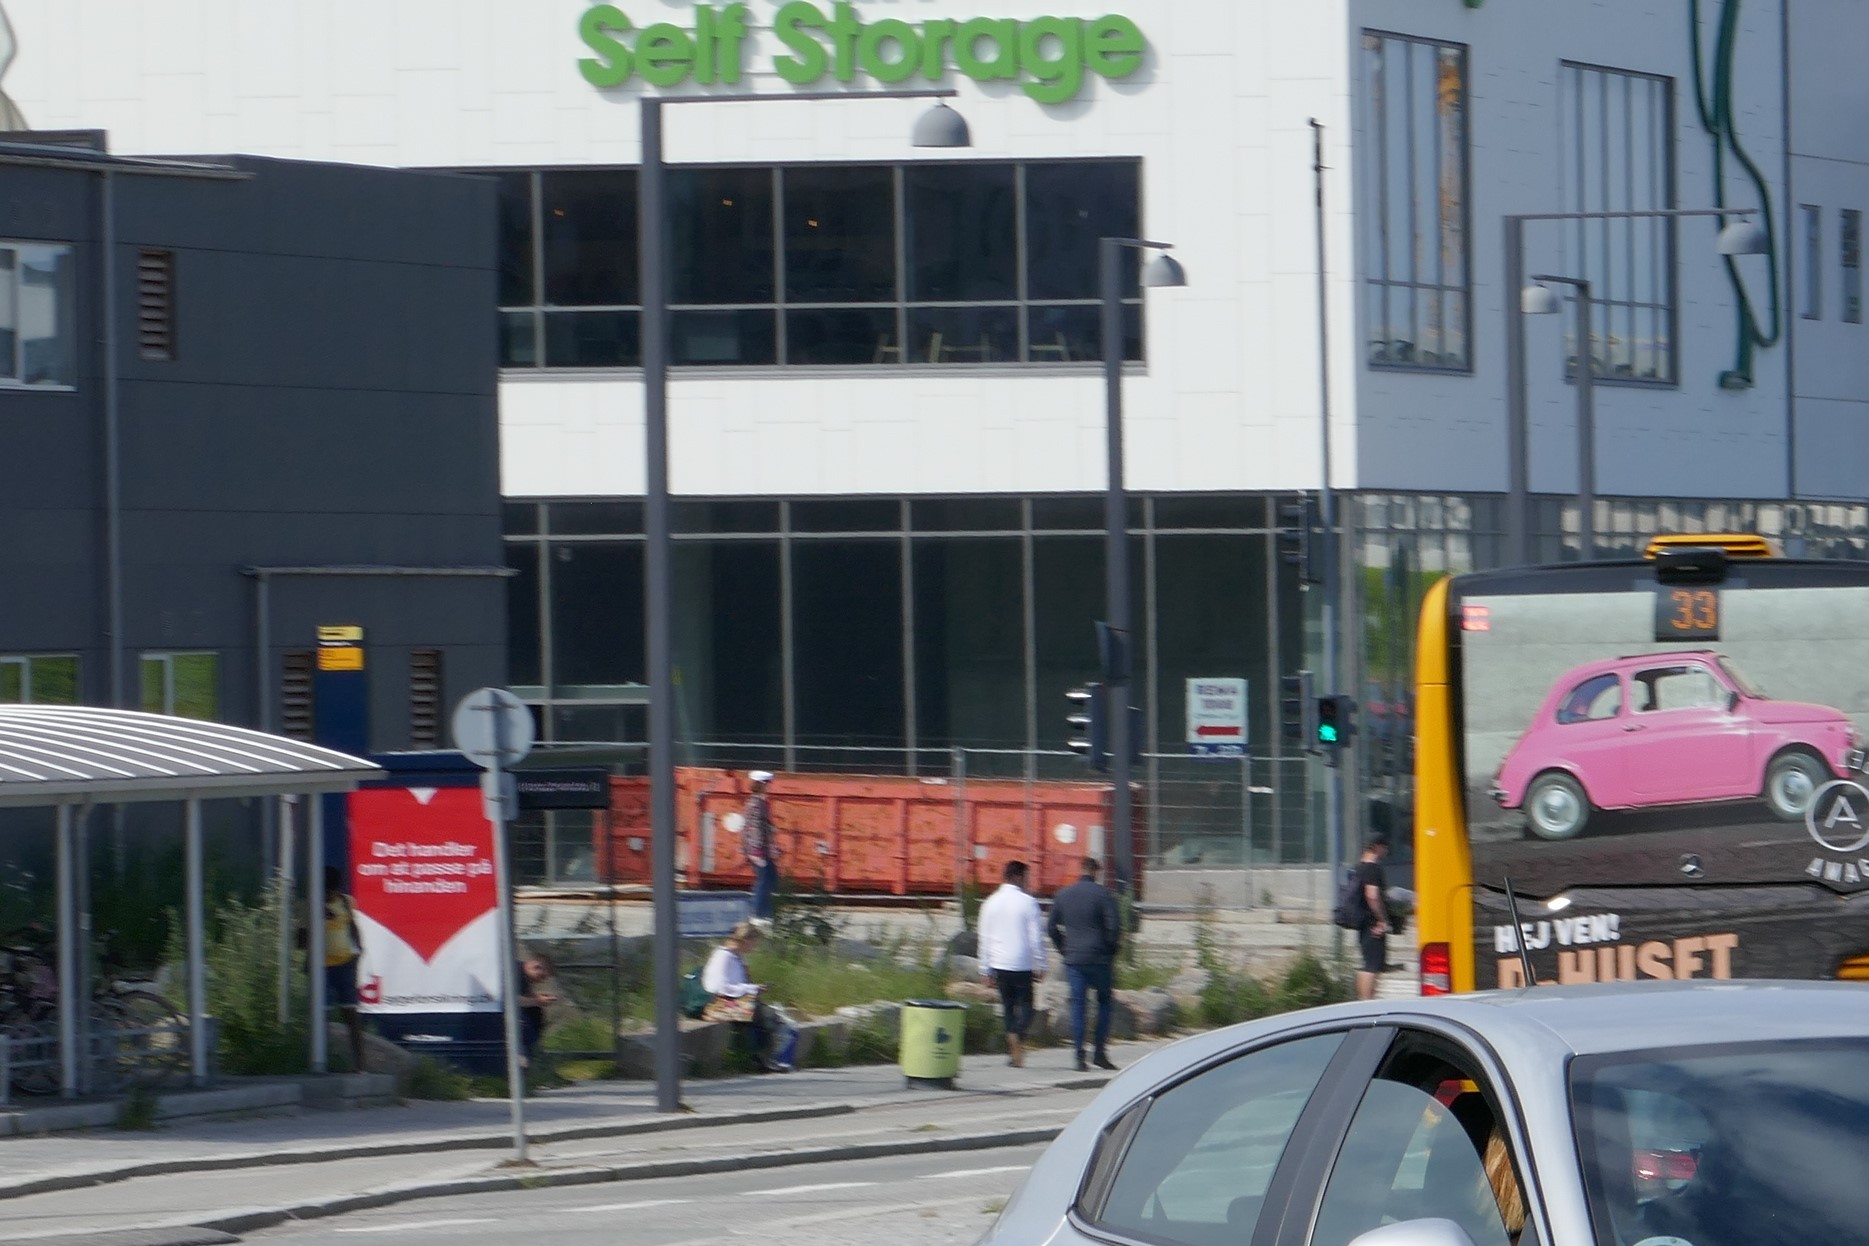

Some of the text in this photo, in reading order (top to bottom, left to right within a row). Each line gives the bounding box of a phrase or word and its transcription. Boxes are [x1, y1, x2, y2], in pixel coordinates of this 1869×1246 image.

[578, 1, 1144, 104] Self Storage
[1671, 590, 1717, 630] 33
[371, 841, 477, 858] Det handler
[357, 863, 389, 877] om
[411, 863, 466, 879] passe
[383, 877, 468, 893] hinanden
[1494, 913, 1621, 953] HEJ VEN!
